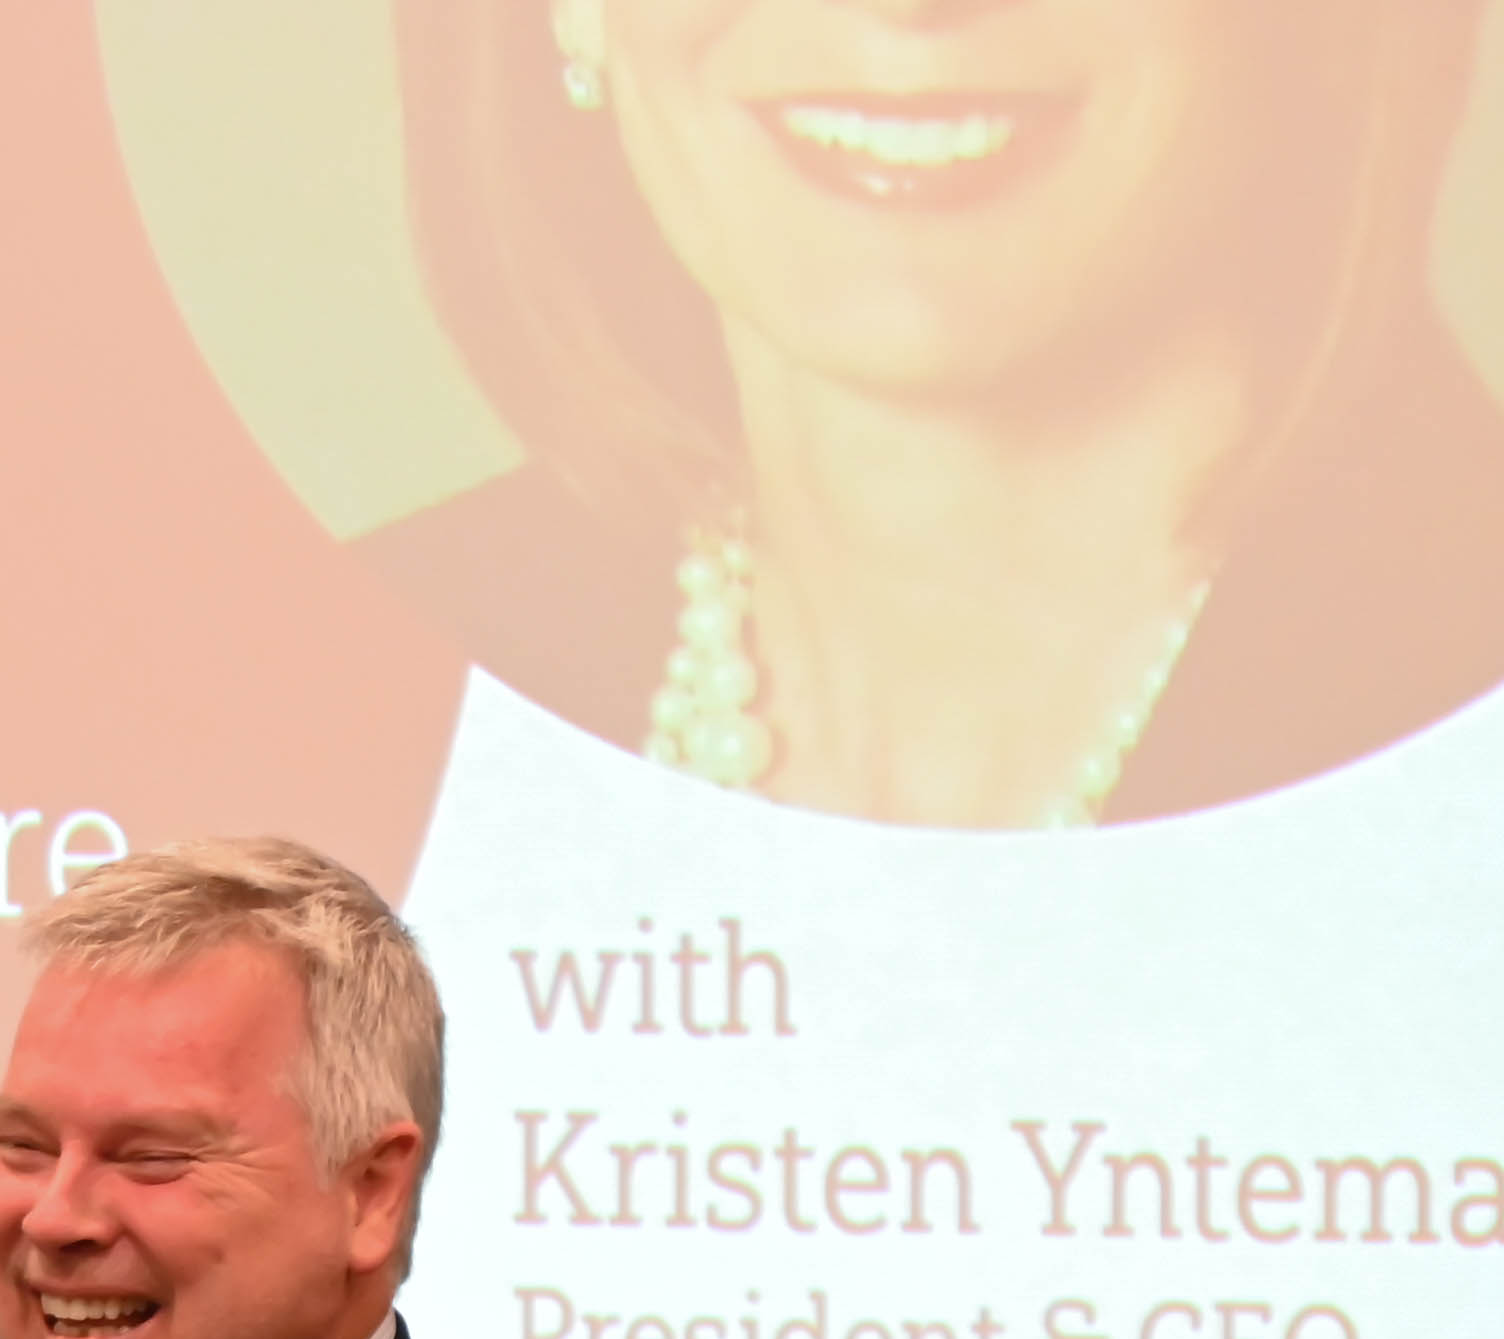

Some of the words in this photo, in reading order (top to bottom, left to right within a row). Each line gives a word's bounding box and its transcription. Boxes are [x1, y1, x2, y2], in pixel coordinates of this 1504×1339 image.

[508, 915, 799, 1039] with
[512, 1109, 982, 1236] Kristen
[1009, 1118, 1504, 1249] Yntema
